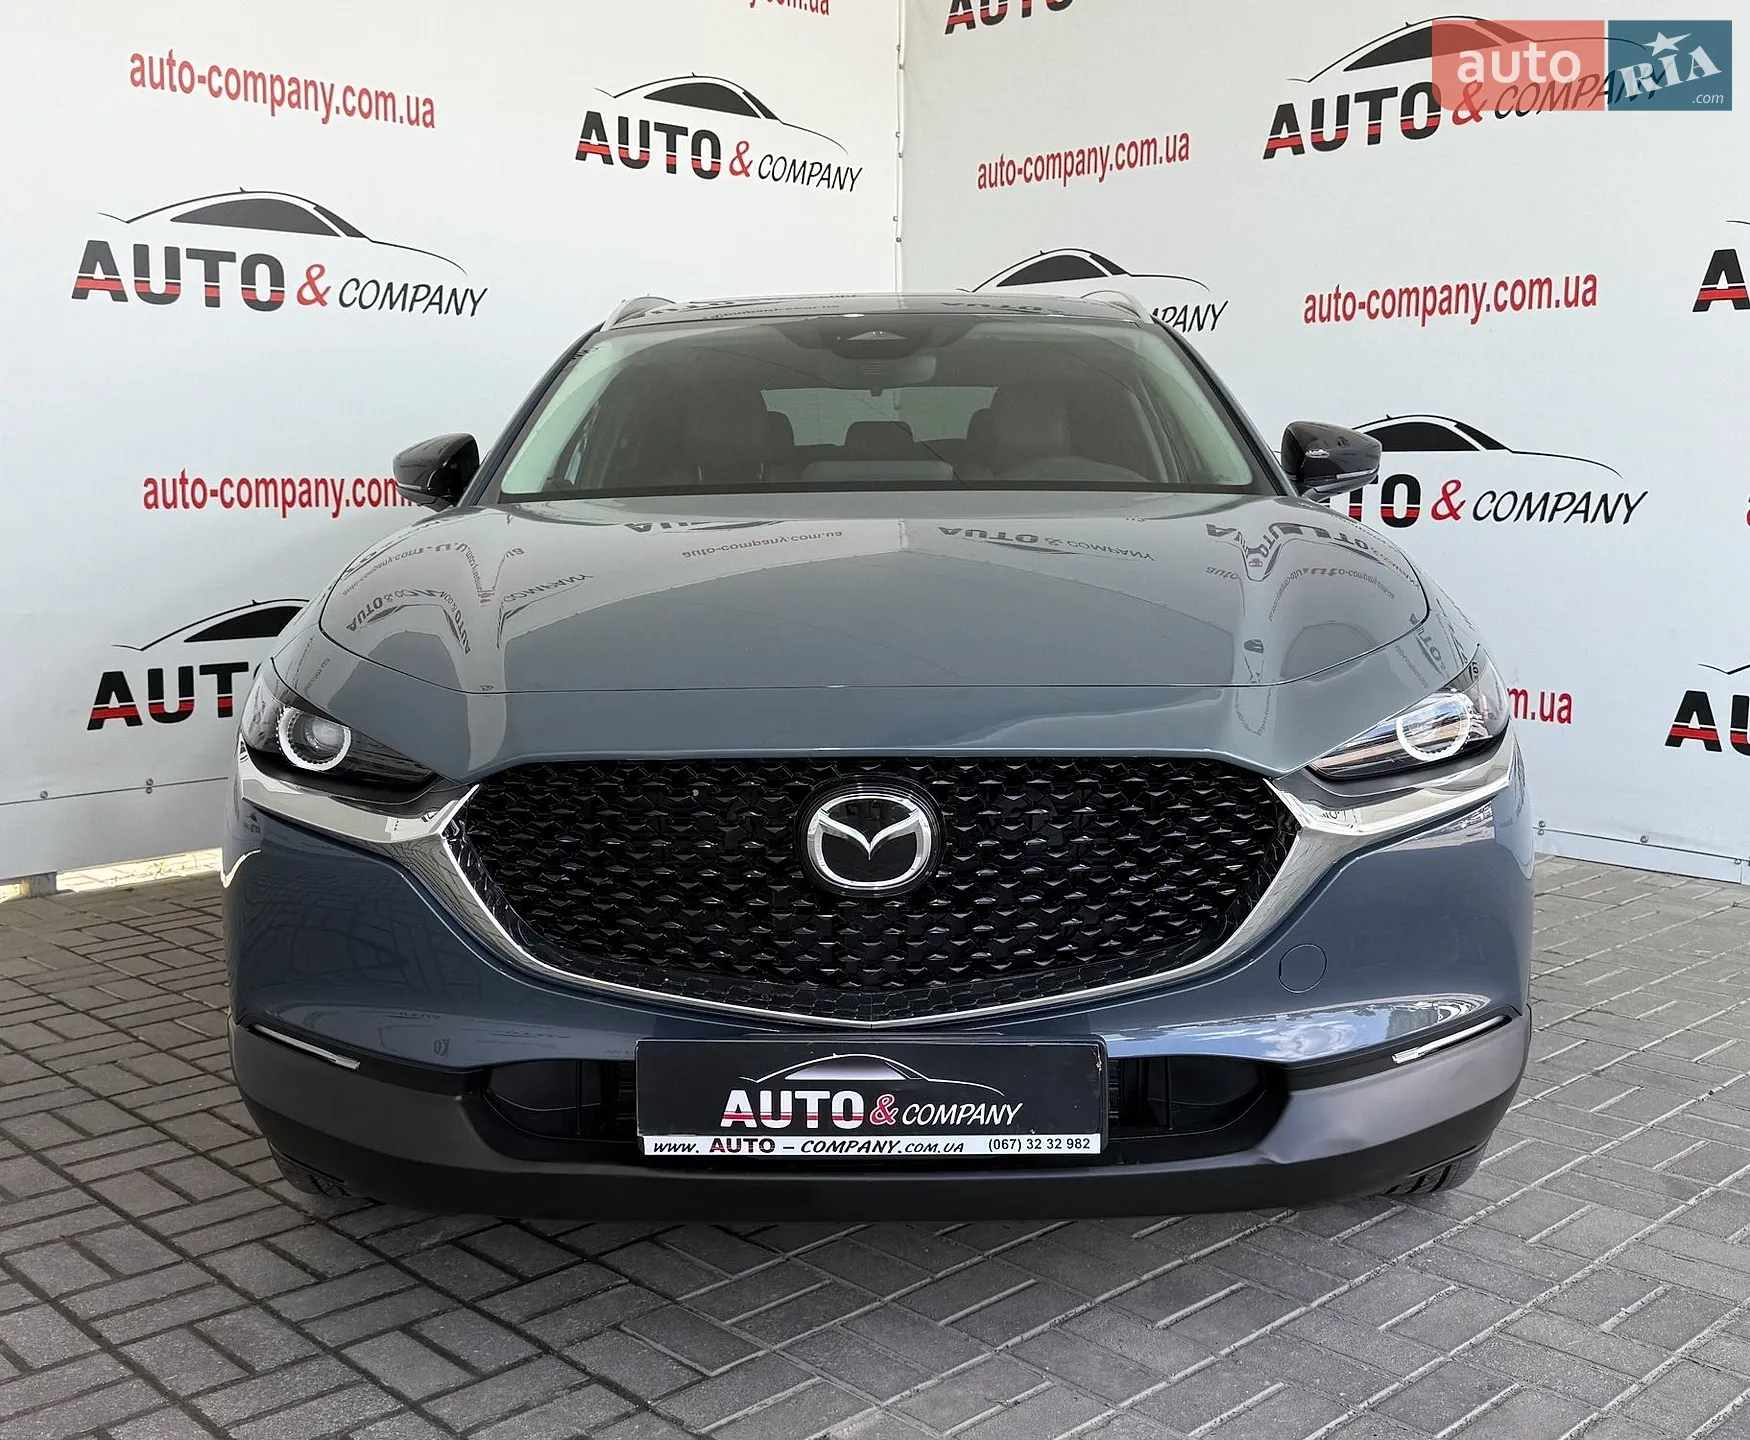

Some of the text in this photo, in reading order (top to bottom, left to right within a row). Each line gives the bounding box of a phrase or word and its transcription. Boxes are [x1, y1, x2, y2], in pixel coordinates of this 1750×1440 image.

[130, 50, 435, 128] auto-company.com.ua
[1263, 81, 1441, 159] AUTO
[1452, 79, 1487, 126] &
[575, 111, 862, 192] AUTO & COMPANY
[977, 132, 1190, 190] auto-company.com.ua
[72, 240, 488, 317] AUTO & COMPANY
[1304, 274, 1597, 327] auto-company.com.ua
[1431, 480, 1465, 521] &
[1473, 491, 1649, 525] COMPANY
[720, 1089, 1023, 1130] AUTO & COMPANY
[709, 1138, 775, 1154] AUTO
[988, 1138, 1091, 1153] (067) 32 32 982
